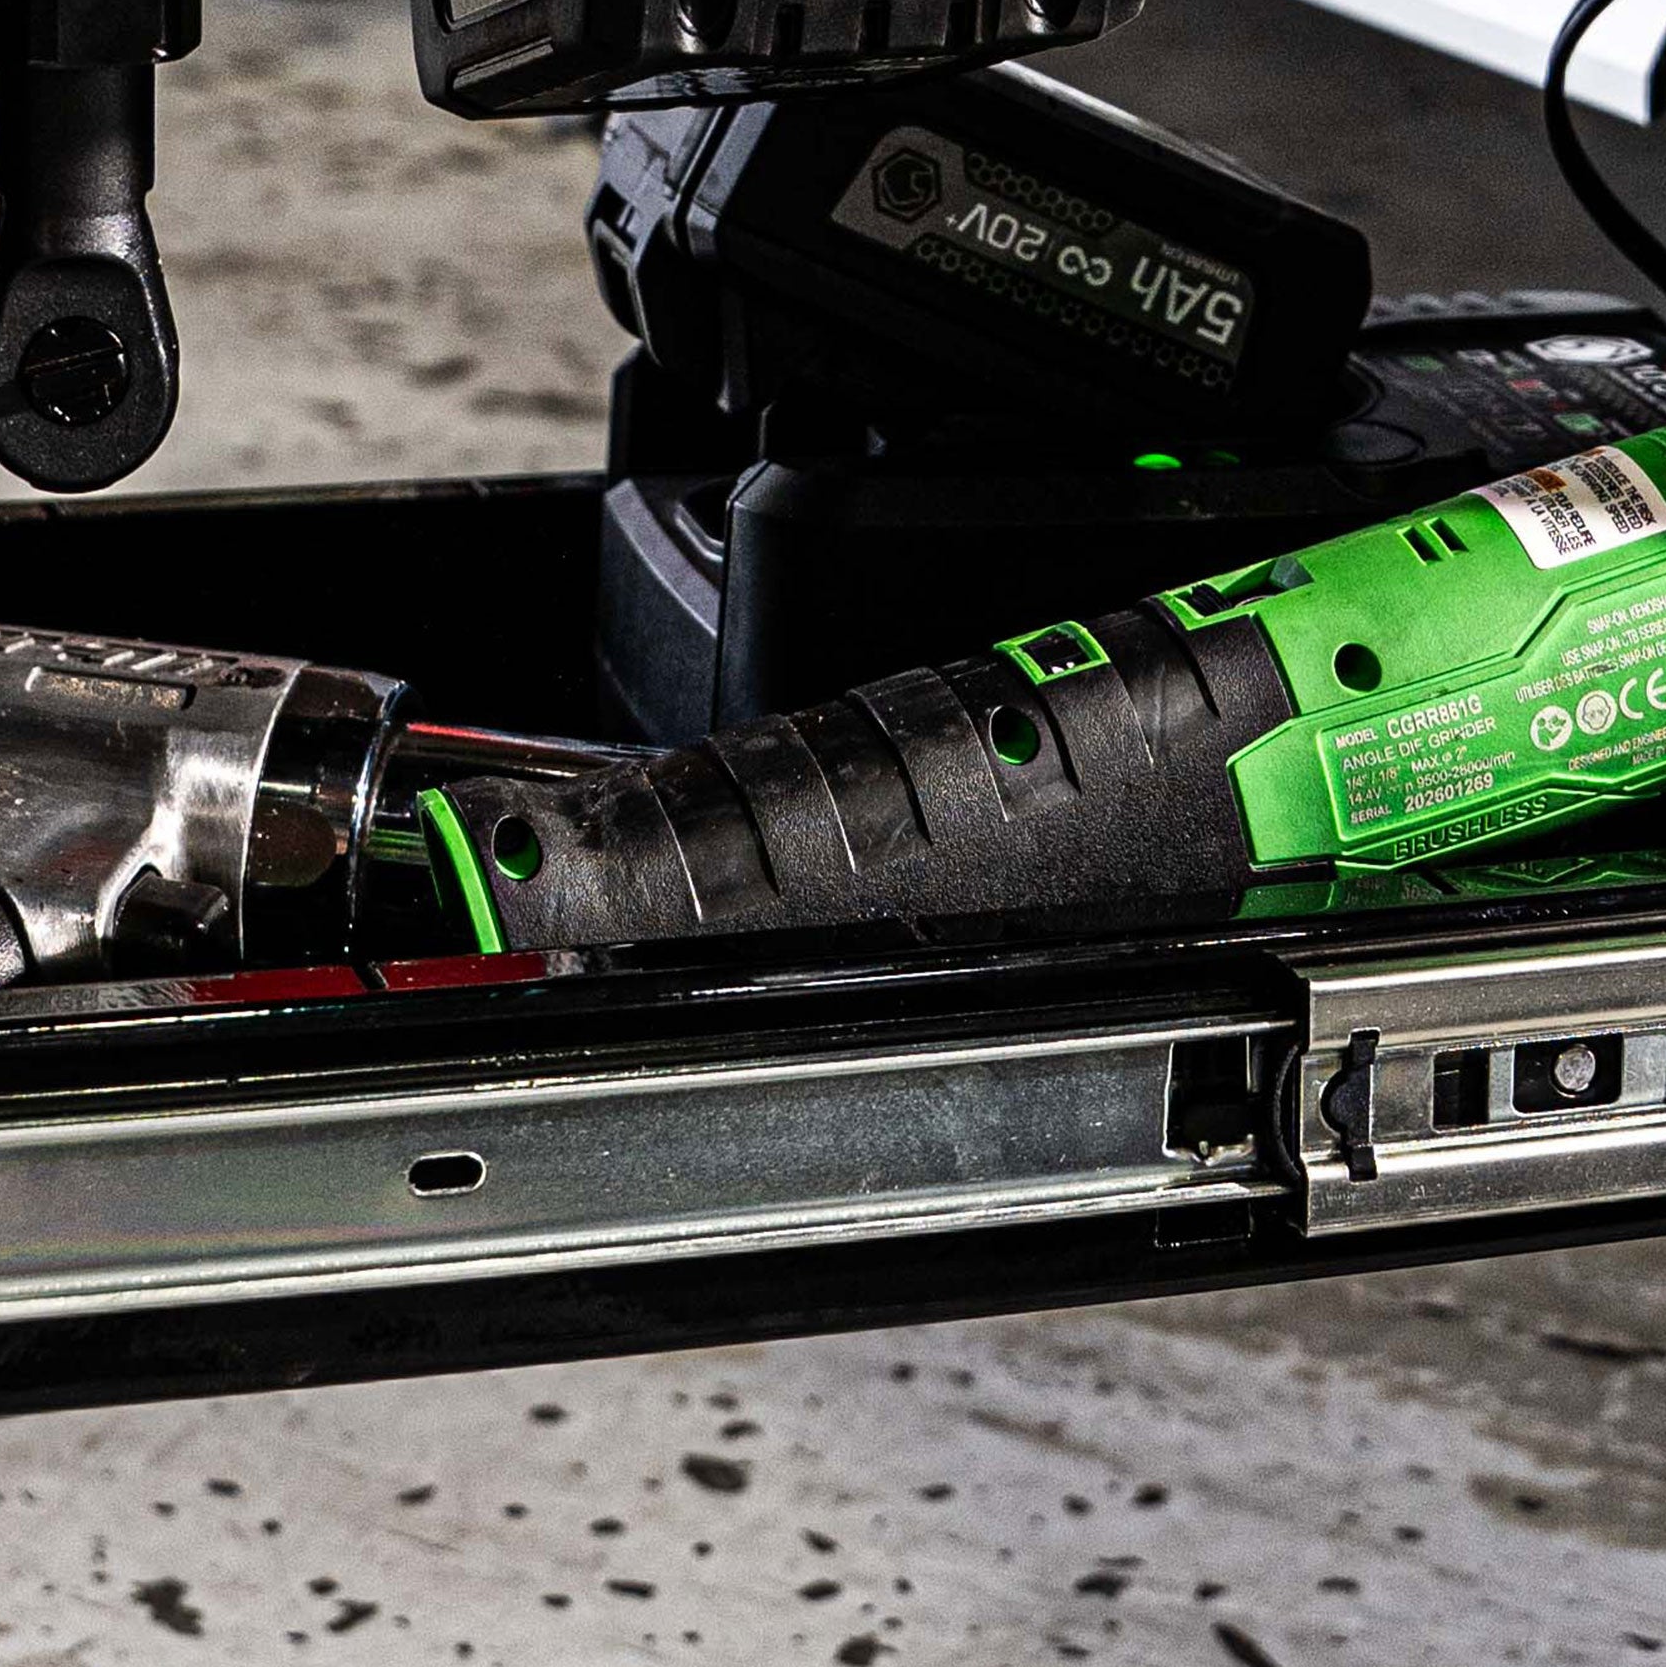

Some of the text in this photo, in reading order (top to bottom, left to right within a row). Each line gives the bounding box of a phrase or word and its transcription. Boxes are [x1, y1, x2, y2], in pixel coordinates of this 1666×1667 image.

[1129, 255, 1244, 347] 5Ah
[1605, 502, 1631, 534] SPEED
[1564, 529, 1583, 550] LES
[1560, 651, 1580, 667] USE
[1581, 637, 1622, 661] SNAP-ON
[1515, 678, 1555, 704] UTILISER
[1618, 646, 1657, 671] SNAP-ON
[1336, 728, 1379, 749] MODEL
[1342, 746, 1395, 772] ANGLE
[1428, 716, 1497, 749] GRINDER
[1612, 741, 1632, 756] AND
[1348, 786, 1382, 806] 14.4V
[1350, 804, 1392, 825] SERIAL
[1393, 795, 1548, 861] BRUSHLESS
